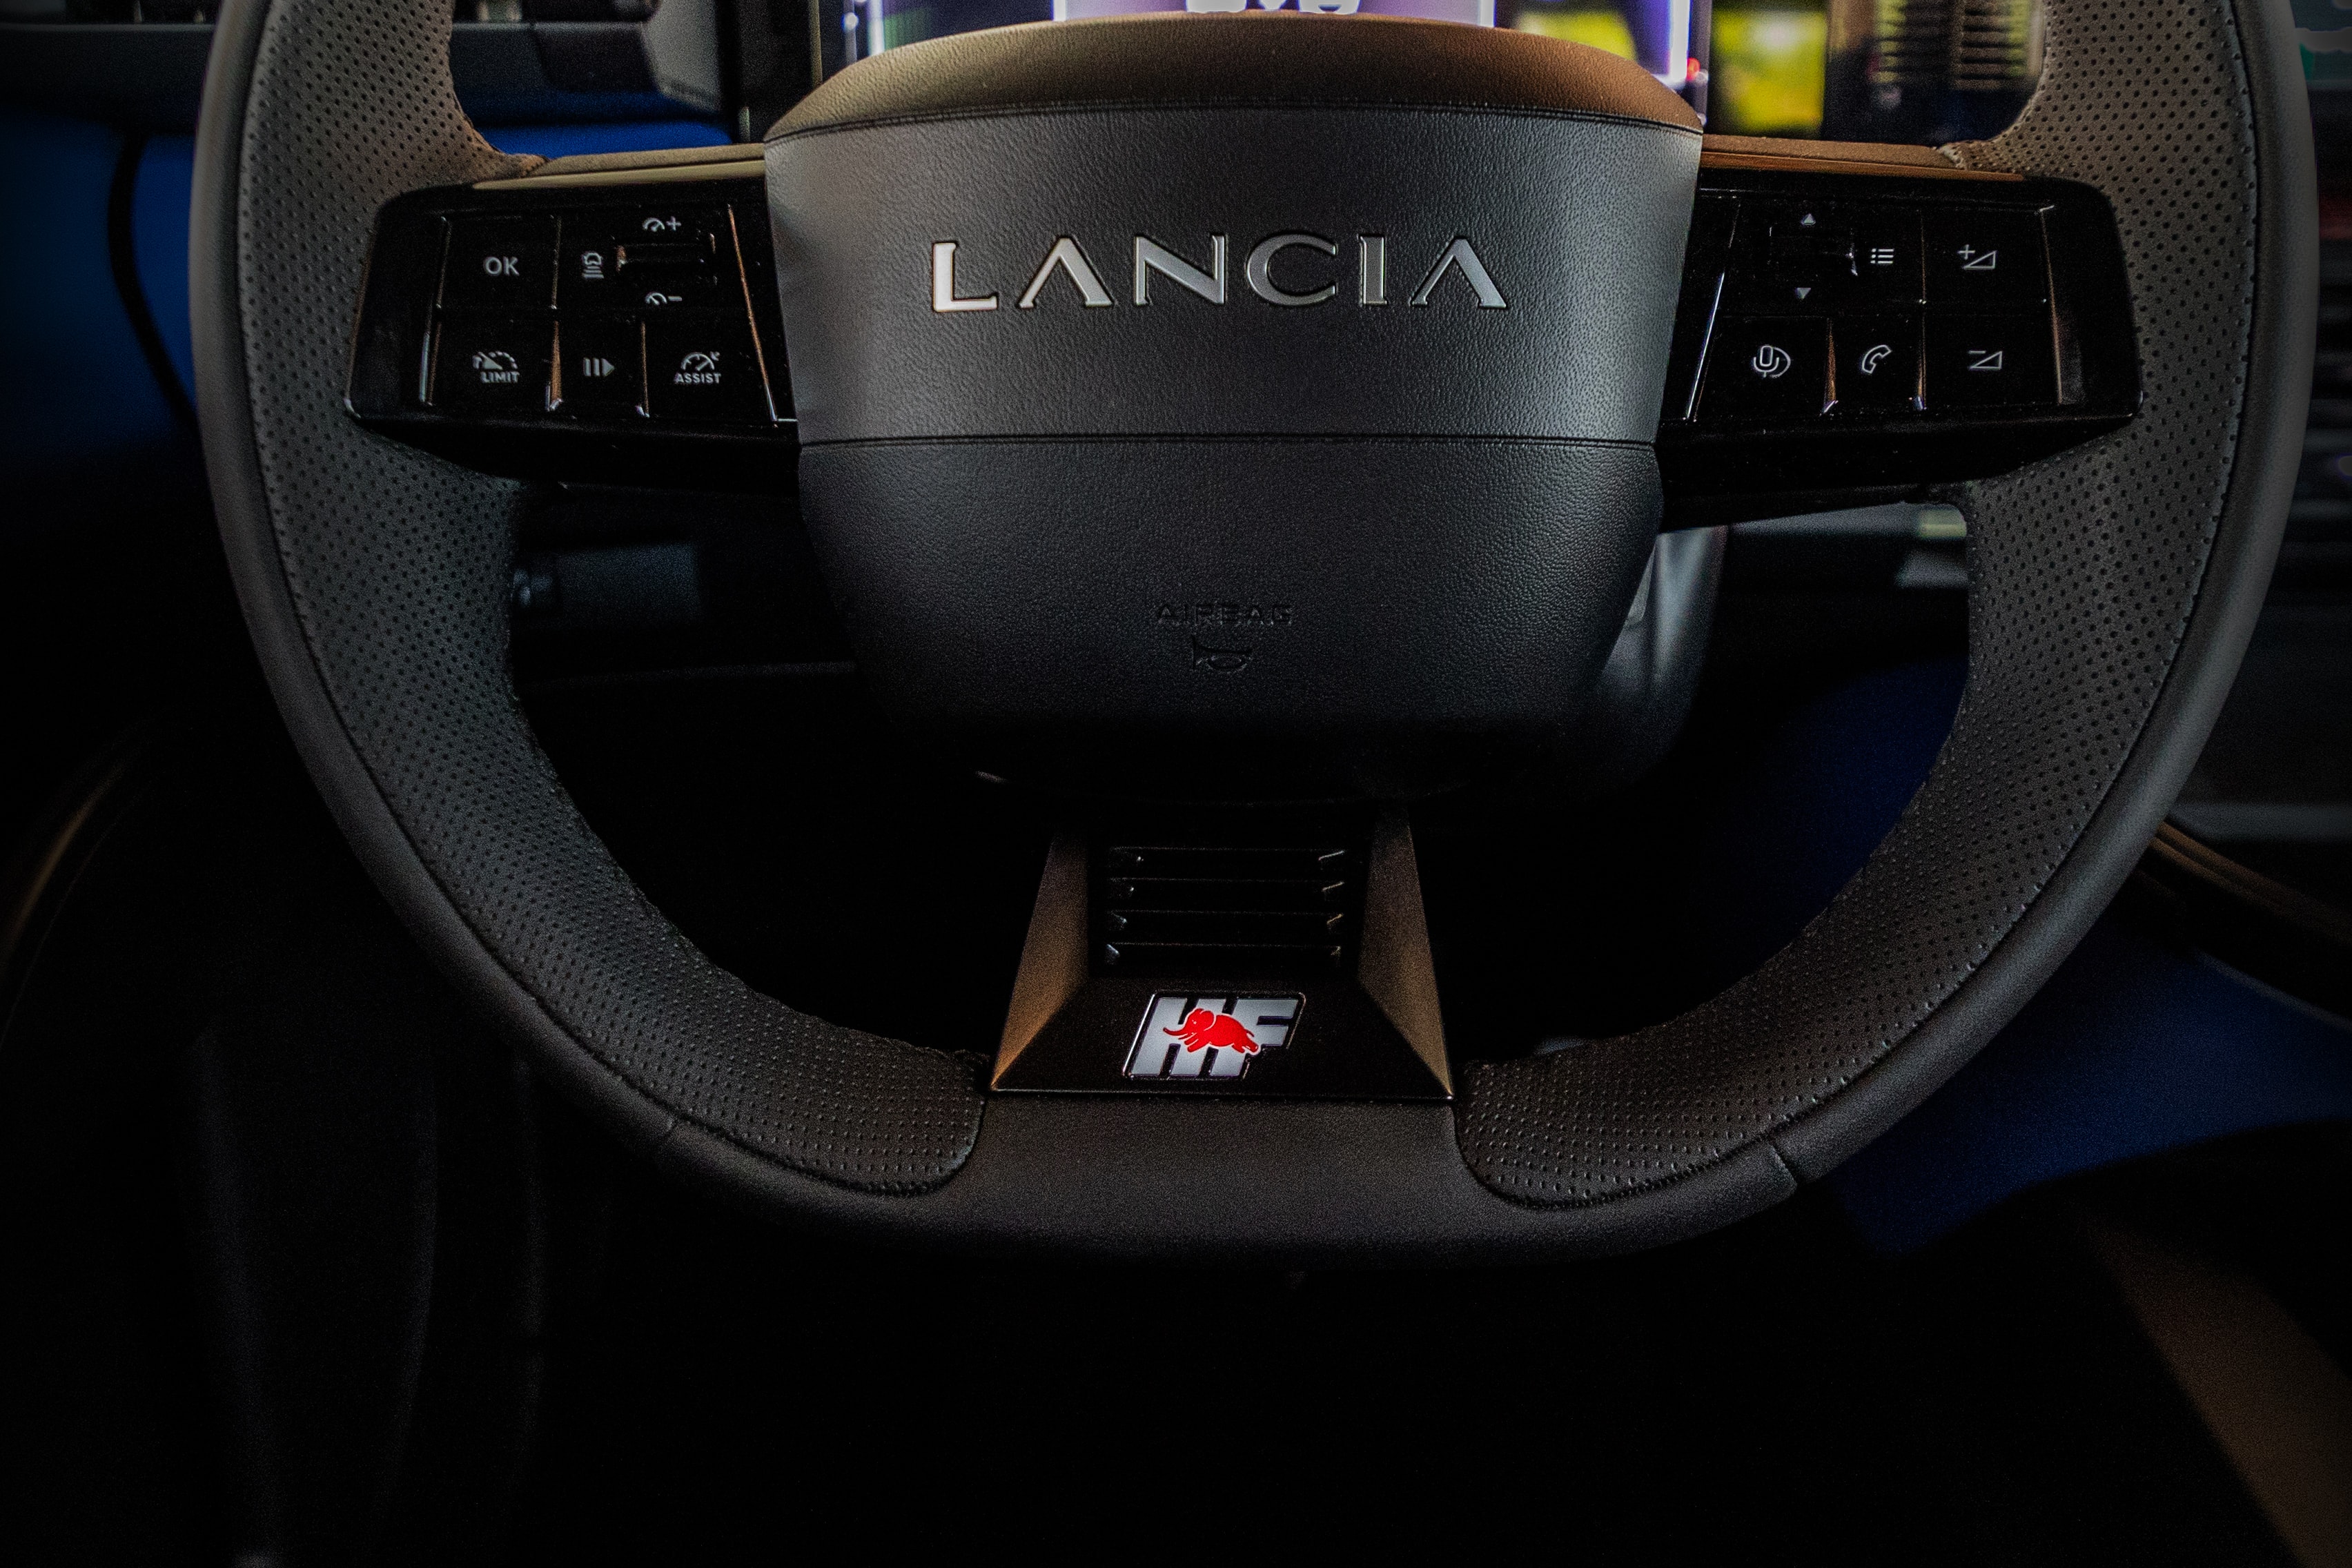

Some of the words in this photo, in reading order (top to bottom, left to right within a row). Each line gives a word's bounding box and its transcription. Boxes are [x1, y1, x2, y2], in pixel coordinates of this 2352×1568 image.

[483, 256, 520, 277] OK
[930, 230, 1509, 313] LANCIA
[481, 371, 519, 384] LIMIT
[674, 372, 722, 384] ASSIST
[1157, 602, 1293, 623] AIRBAG
